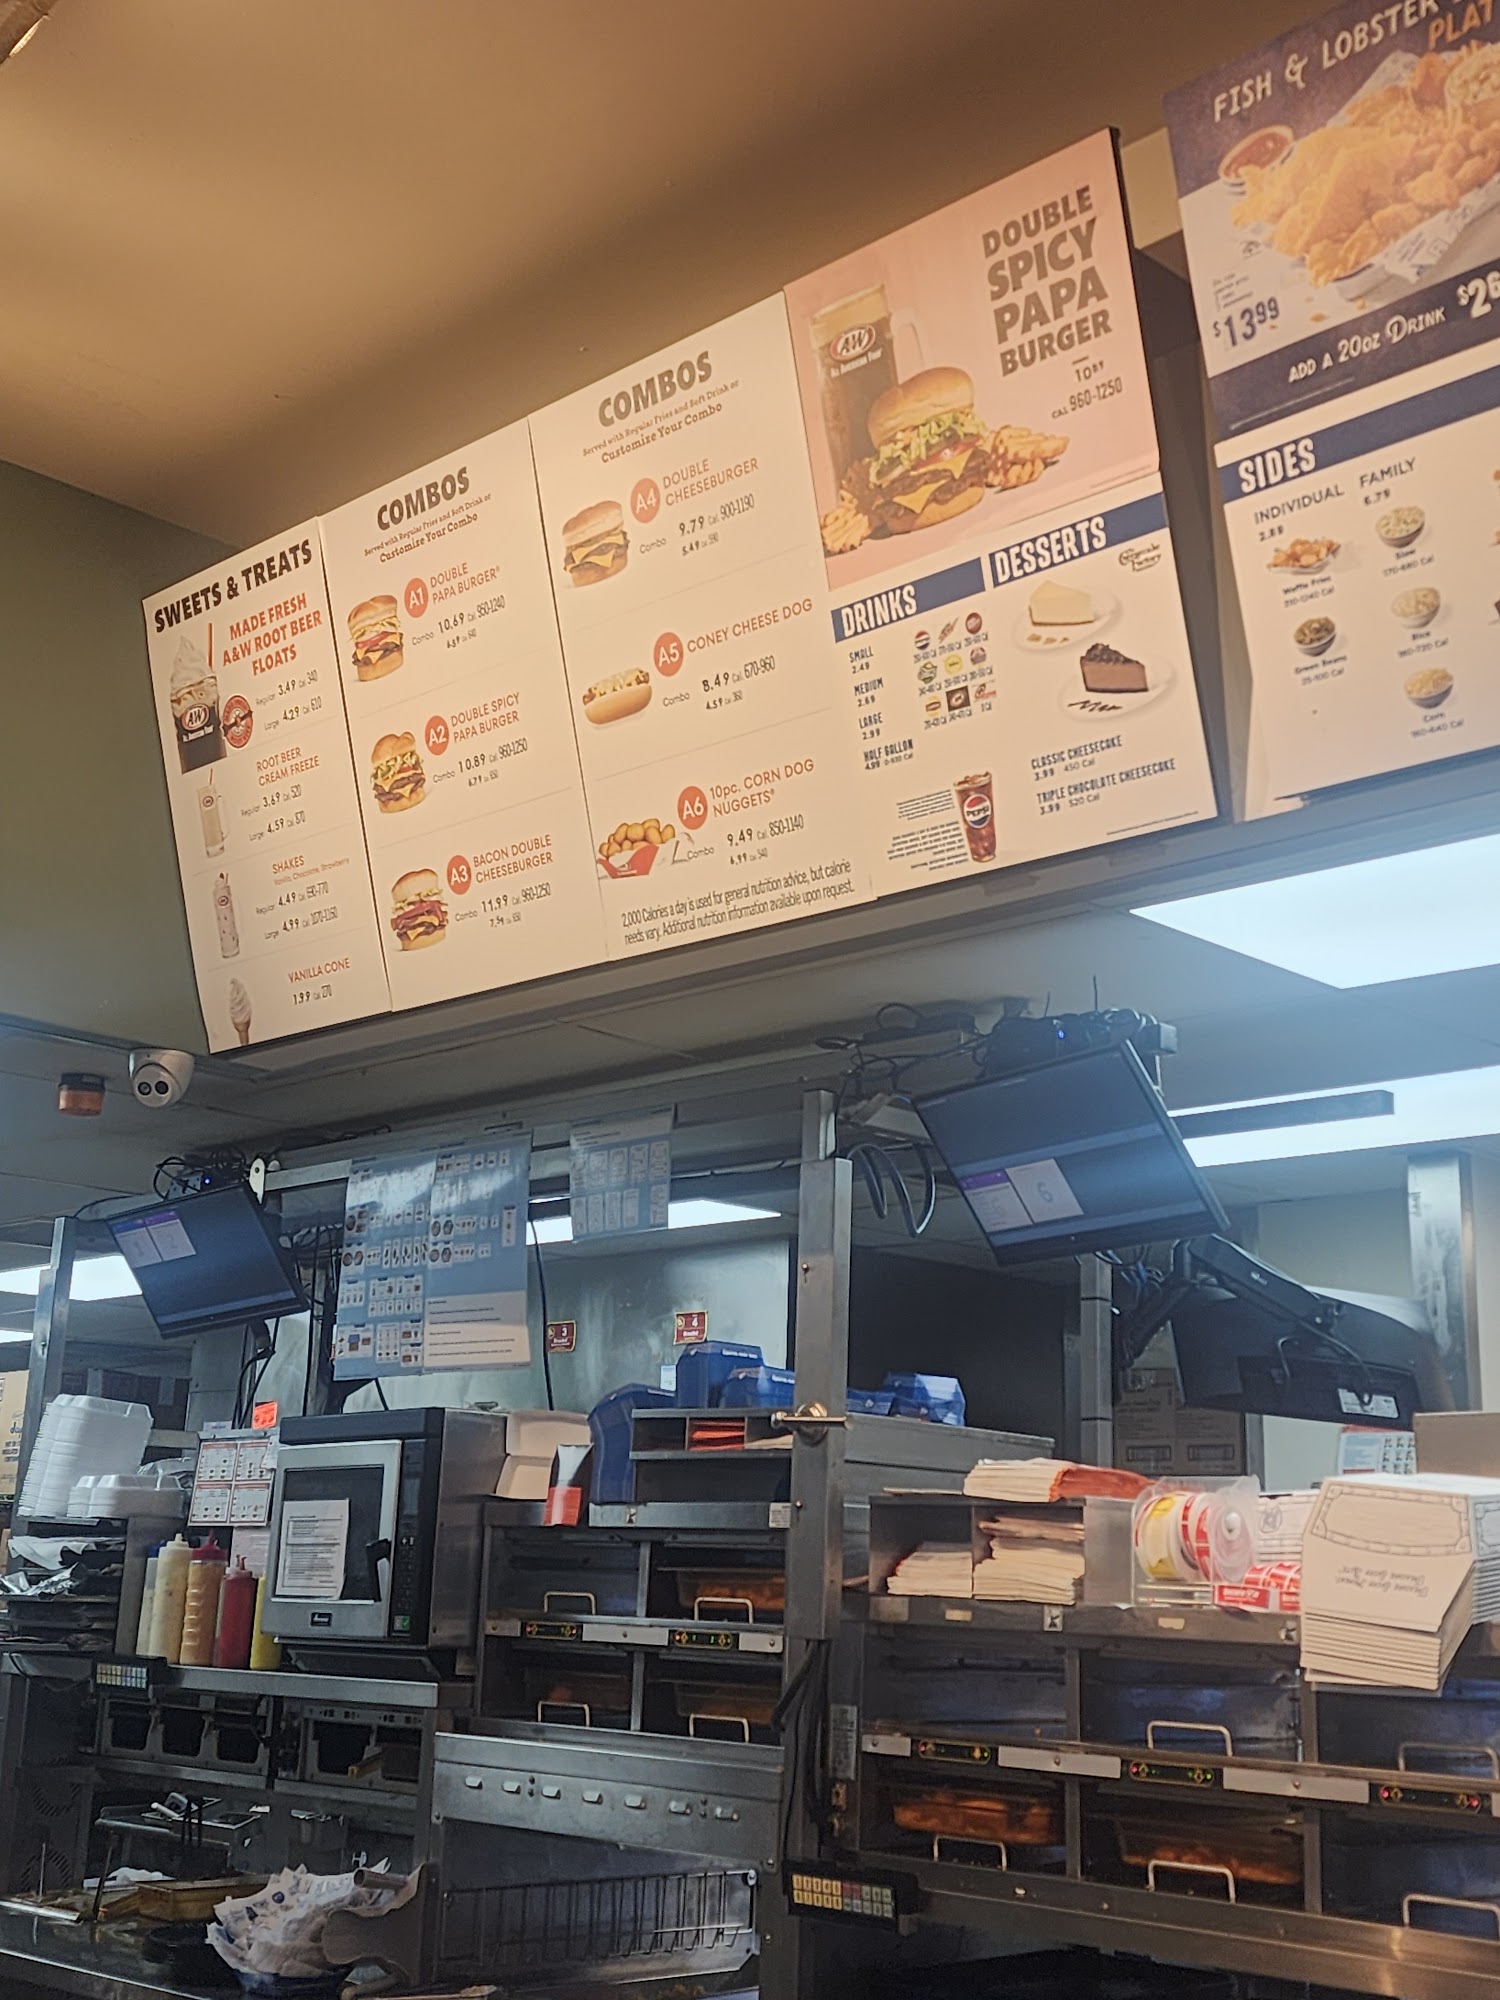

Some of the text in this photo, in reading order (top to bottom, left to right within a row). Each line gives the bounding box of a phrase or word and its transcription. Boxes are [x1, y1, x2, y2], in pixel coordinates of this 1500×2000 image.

[1214, 65, 1272, 122] FISH
[1285, 53, 1308, 90] &
[982, 185, 1093, 258] DOUBLE
[988, 217, 1097, 301] SPICY
[994, 266, 1109, 345] PAPA
[1000, 309, 1112, 377] BURGER
[1289, 359, 1316, 383] ADD
[1322, 352, 1333, 370] A
[599, 351, 713, 427] COMBOS
[583, 380, 738, 457] Served with Regular Fries and Soft Drink or
[602, 403, 722, 463] Customize Your Combo
[663, 459, 709, 489] DOUBLE
[1239, 438, 1316, 493] SIDES
[1359, 457, 1416, 488] FAMILY
[665, 457, 759, 506] CHEESEBURGER
[377, 466, 470, 531] COMBOS
[635, 488, 656, 514] A4
[1255, 484, 1345, 525] INDIVIDUAL
[364, 494, 491, 557] Served with Regular Fries and Soft Drink or
[380, 513, 478, 562] Customize Your Combo
[679, 516, 704, 537] 9.79
[640, 538, 667, 554] Combo
[994, 517, 1107, 584] DESSERTS
[155, 539, 312, 633] SWEETS & TREATS
[430, 563, 468, 588] DOUBLE
[409, 590, 424, 609] A1
[432, 585, 456, 604] PAPA
[230, 593, 307, 640] MADE FRESH
[438, 613, 465, 634] 10.69
[687, 599, 812, 653] CONEY CHEESE DOG
[842, 585, 917, 638] DRINKS
[223, 611, 322, 666] A&W ROOT BEER
[252, 645, 297, 676] FLOATS
[658, 643, 680, 667] A5
[849, 647, 873, 663] SMALL
[278, 679, 296, 696] 3.49
[702, 672, 729, 693] 8.49
[854, 678, 884, 696] MEDIUM
[283, 705, 300, 720] 4.29
[451, 692, 520, 727] DOUBLE SPICY
[663, 692, 690, 707] Combo
[429, 726, 447, 746] A2
[453, 711, 519, 743] PAPA BURGER
[859, 712, 883, 729] LARGE
[256, 747, 301, 772] ROOT BEER
[459, 753, 486, 773] 10.89
[864, 739, 913, 762] HALF GALLON
[1031, 735, 1122, 769] CLASSIC CHEESECAKE
[259, 756, 319, 787] CREAM FREEZE
[710, 759, 814, 801] 10pc. CORN DOG
[1037, 758, 1175, 804] TRIPLE CHOCOLATE CHEESECAKE
[263, 791, 280, 808] 3.69
[682, 797, 704, 820] A6
[267, 817, 284, 833] 4.59
[727, 828, 753, 847] 9.49
[272, 855, 304, 875] SHAKES
[473, 835, 552, 868] BACON DOUBLE
[687, 847, 714, 860] Combo
[451, 865, 469, 885] A3
[476, 852, 553, 883] CHEESEBURGER
[278, 892, 296, 907] 4.49
[482, 895, 508, 913] 11.99
[643, 902, 669, 921] Calories
[675, 900, 688, 916] day
[689, 897, 695, 910] is
[696, 895, 712, 910] used
[713, 890, 723, 905] for
[725, 884, 751, 906] general
[751, 876, 782, 895] nutrition
[811, 866, 824, 882] but
[825, 860, 851, 878] calorie
[283, 919, 299, 932] 4.99
[625, 929, 644, 944] needs
[663, 915, 696, 936] Additional
[697, 909, 727, 928] nutrition
[728, 900, 768, 921] information
[769, 890, 801, 912] available
[802, 886, 821, 907] upon
[288, 958, 350, 983] VANILLA CONE
